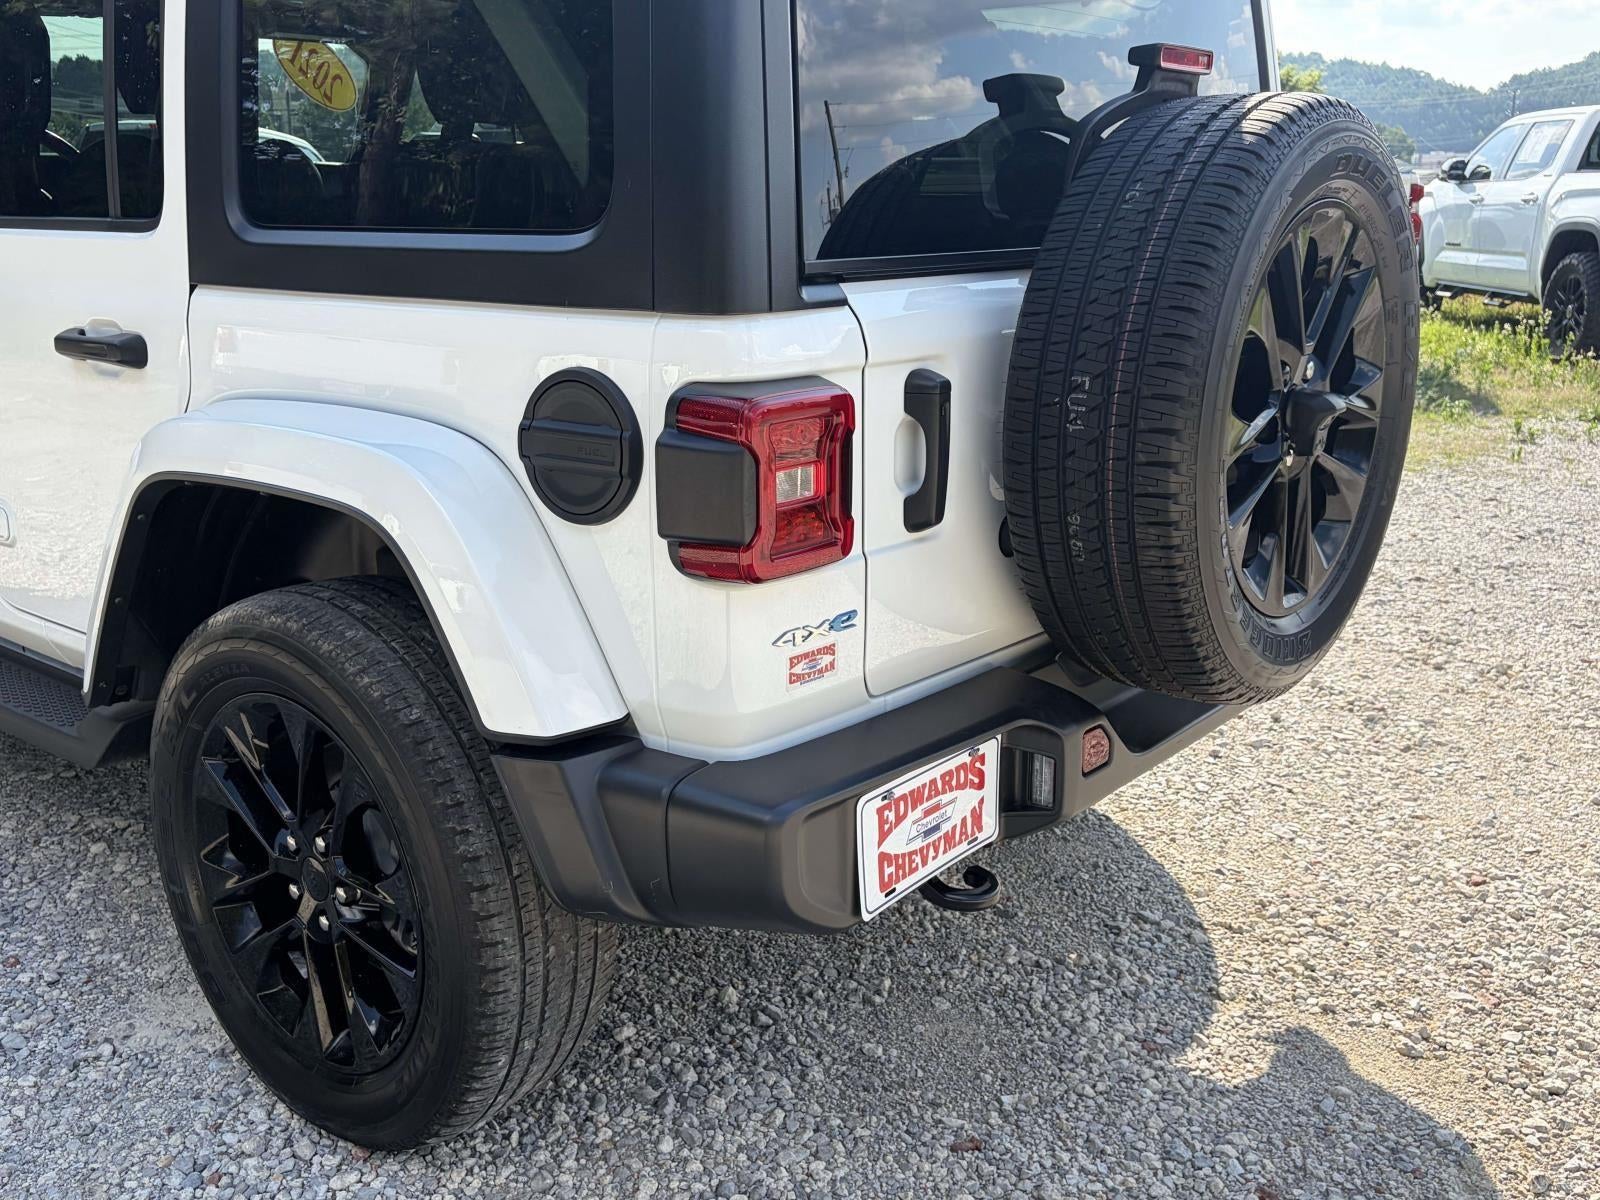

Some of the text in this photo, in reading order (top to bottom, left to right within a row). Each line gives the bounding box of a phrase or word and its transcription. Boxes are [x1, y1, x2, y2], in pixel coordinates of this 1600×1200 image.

[788, 643, 836, 671] EDWARDS
[788, 657, 836, 685] CHEVYMAN
[876, 752, 986, 851] EDWARDS
[915, 810, 948, 833] Chevrolet
[877, 795, 985, 894] CHEVYMAN
